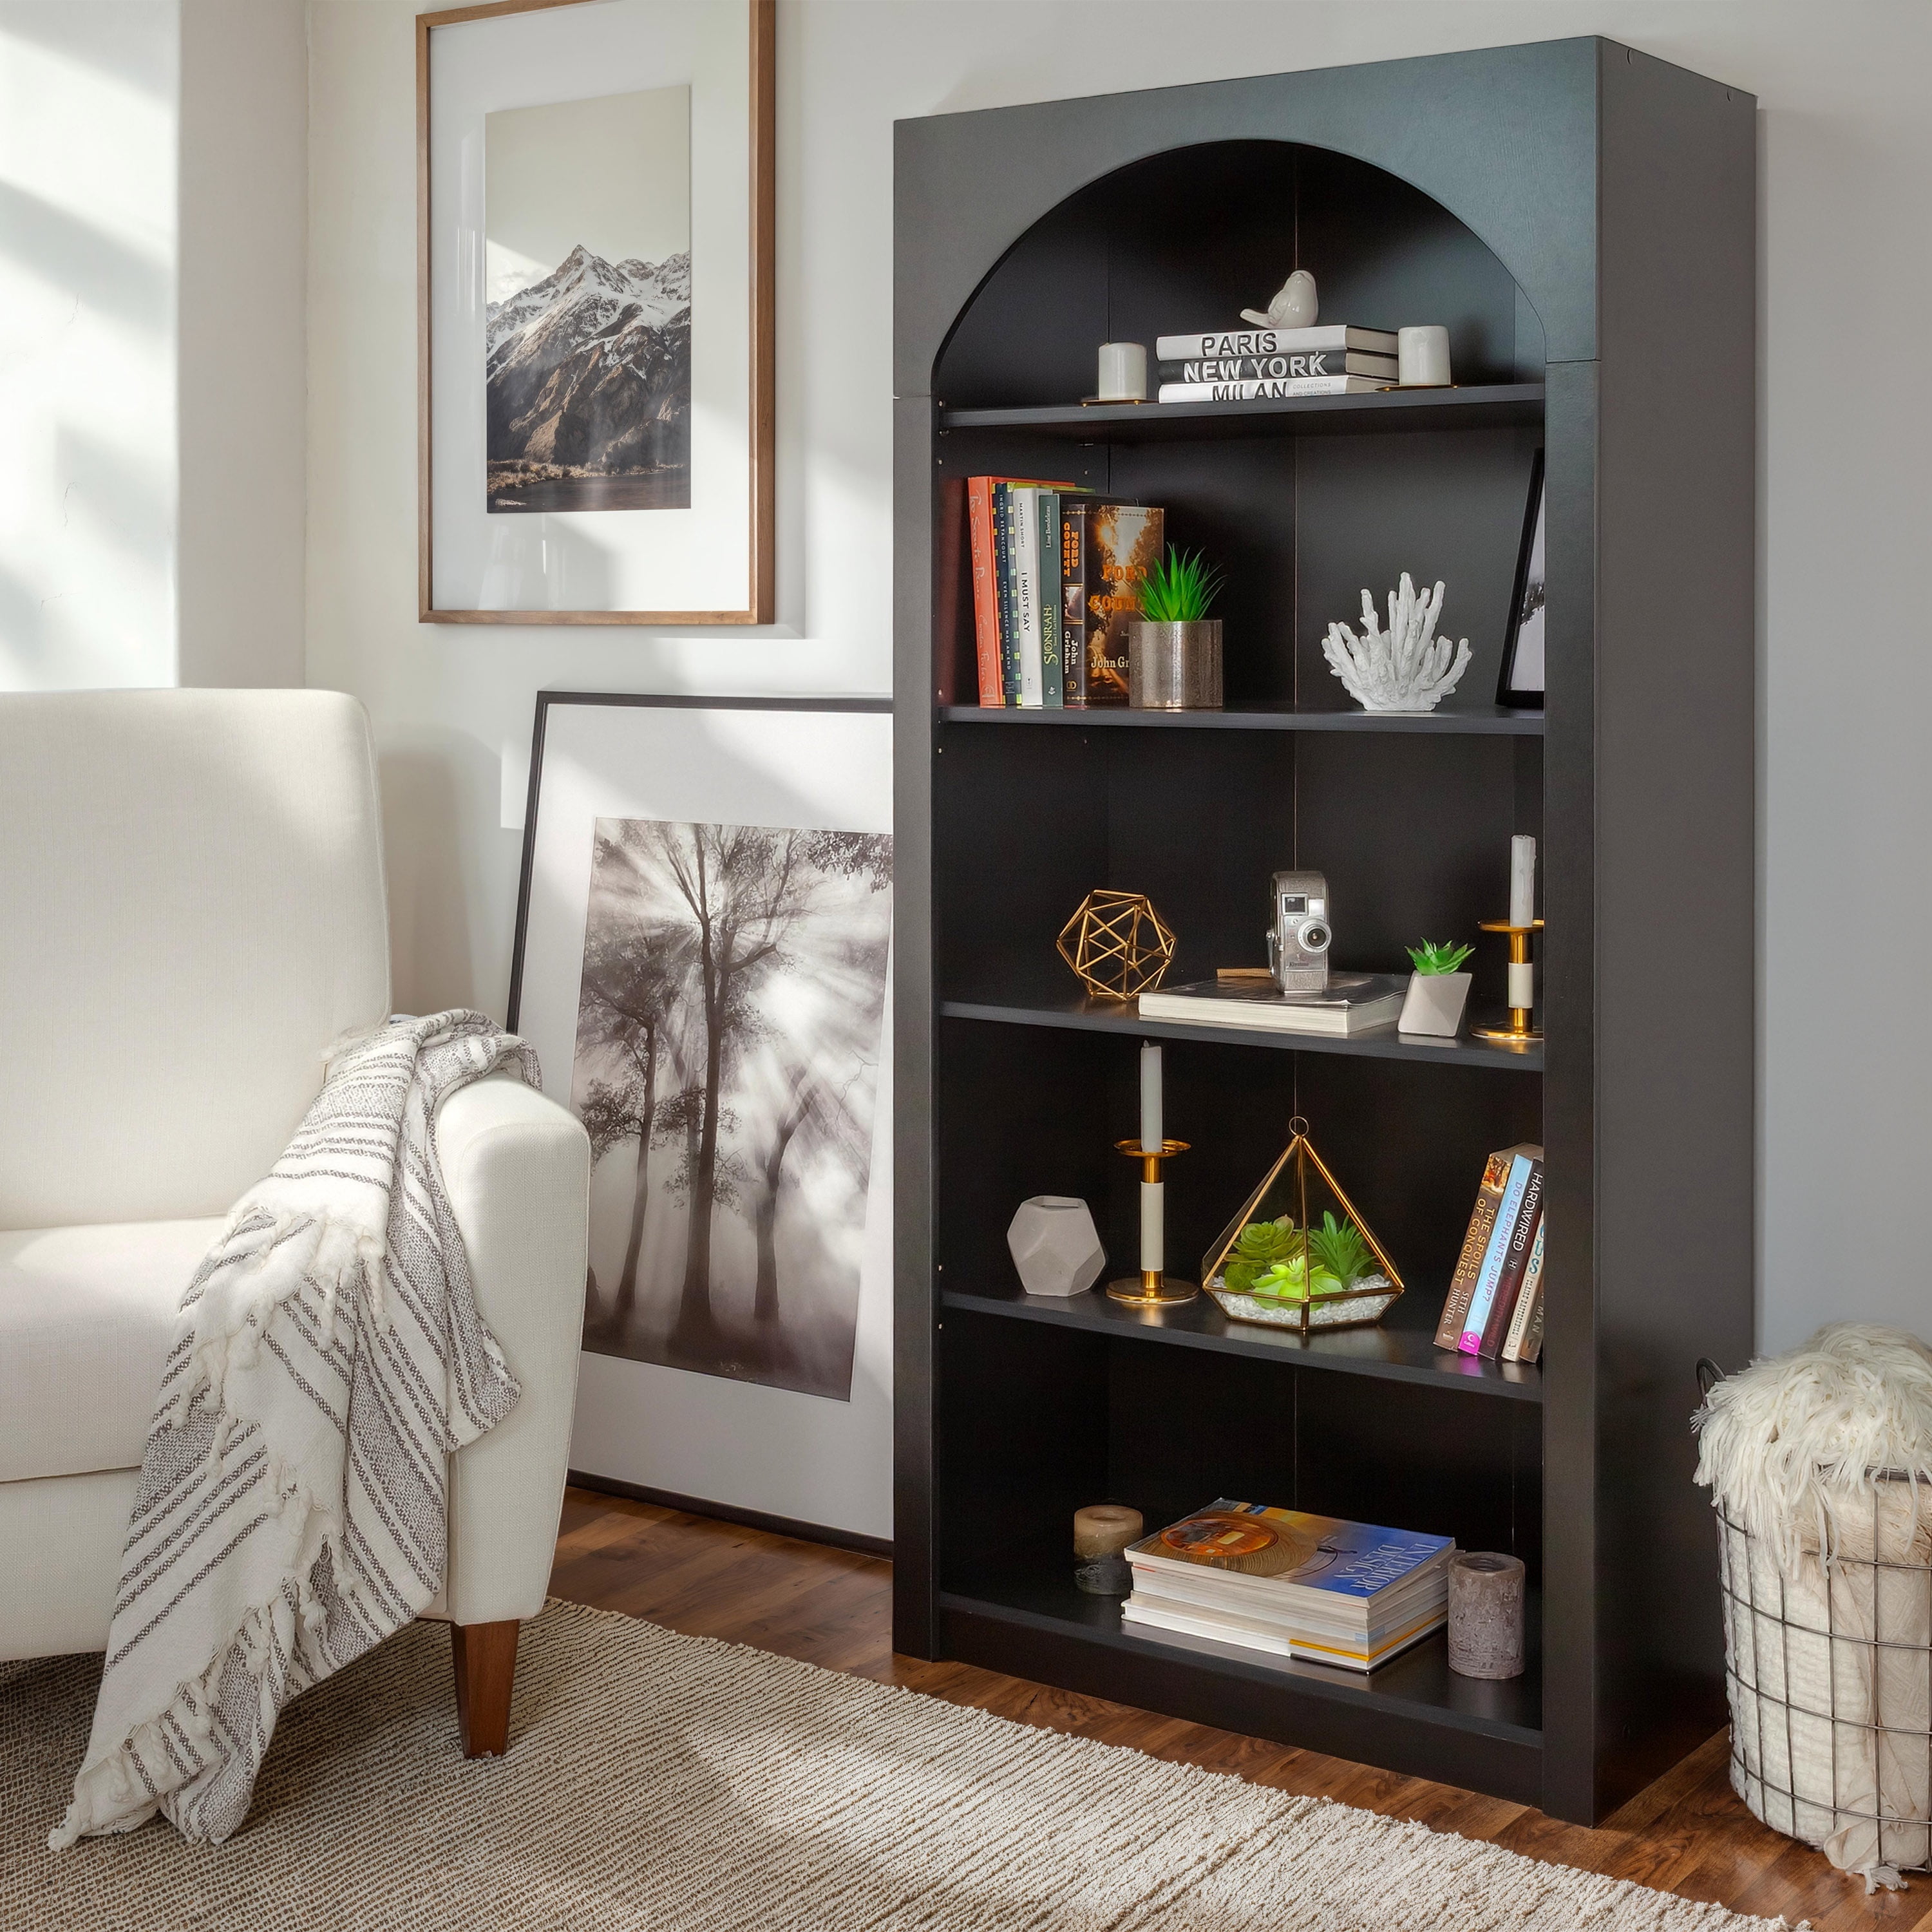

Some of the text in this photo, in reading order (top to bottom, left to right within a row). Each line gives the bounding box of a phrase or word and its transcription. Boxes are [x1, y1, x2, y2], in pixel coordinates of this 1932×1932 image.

[1201, 332, 1277, 357] PARIS
[1184, 354, 1328, 383] NEW YORK
[1212, 381, 1288, 401] MILAN
[1071, 531, 1079, 568] FORD
[1102, 564, 1148, 580] FORD
[1021, 580, 1030, 609] MUST
[1006, 645, 1011, 654] AN
[1091, 656, 1116, 668] John
[1513, 1172, 1543, 1251] HARDWIRED
[1455, 1198, 1486, 1285] OF CONQUEST
[1468, 1208, 1495, 1280] THE SPOILS
[1482, 1182, 1522, 1302] DO ELEPHANTS JUMP?
[1444, 1288, 1461, 1325] HUNTER
[1457, 1291, 1470, 1314] SETH
[1334, 1544, 1406, 1578] DESIGN
[1350, 1543, 1439, 1591] INTERIOR
